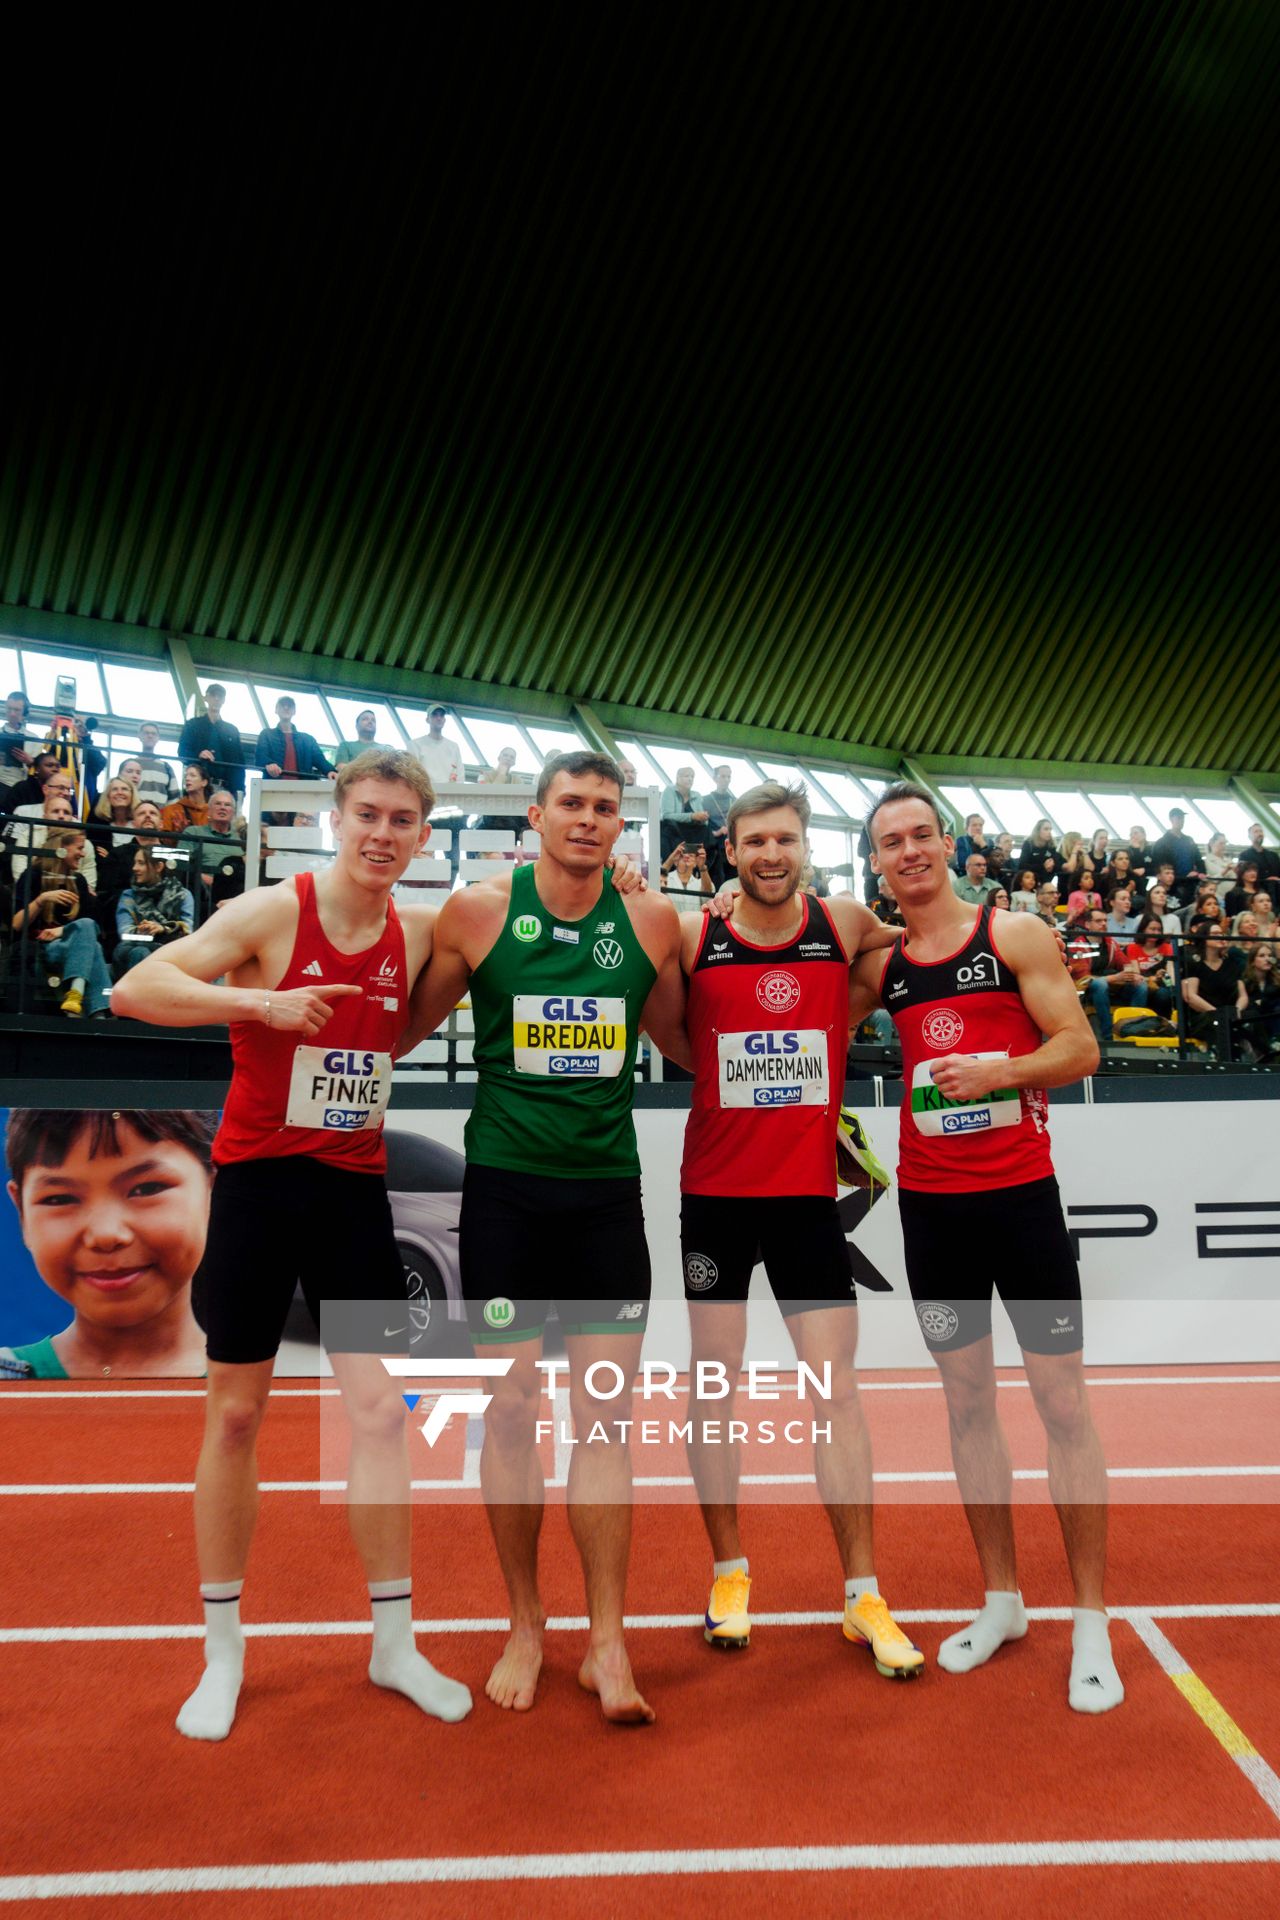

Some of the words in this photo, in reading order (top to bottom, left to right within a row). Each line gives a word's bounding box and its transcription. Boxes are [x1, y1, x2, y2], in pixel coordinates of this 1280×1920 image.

[708, 952, 734, 961] erima
[956, 964, 986, 983] OS
[888, 988, 909, 1000] erima
[527, 1024, 616, 1050] BREDAU
[570, 1058, 598, 1068] PLAN
[726, 1056, 823, 1082] DAMMERMANN
[311, 1076, 381, 1104] FINKE
[773, 1089, 801, 1099] PLAN
[961, 1112, 989, 1124] PLAN
[1050, 1326, 1075, 1335] erima
